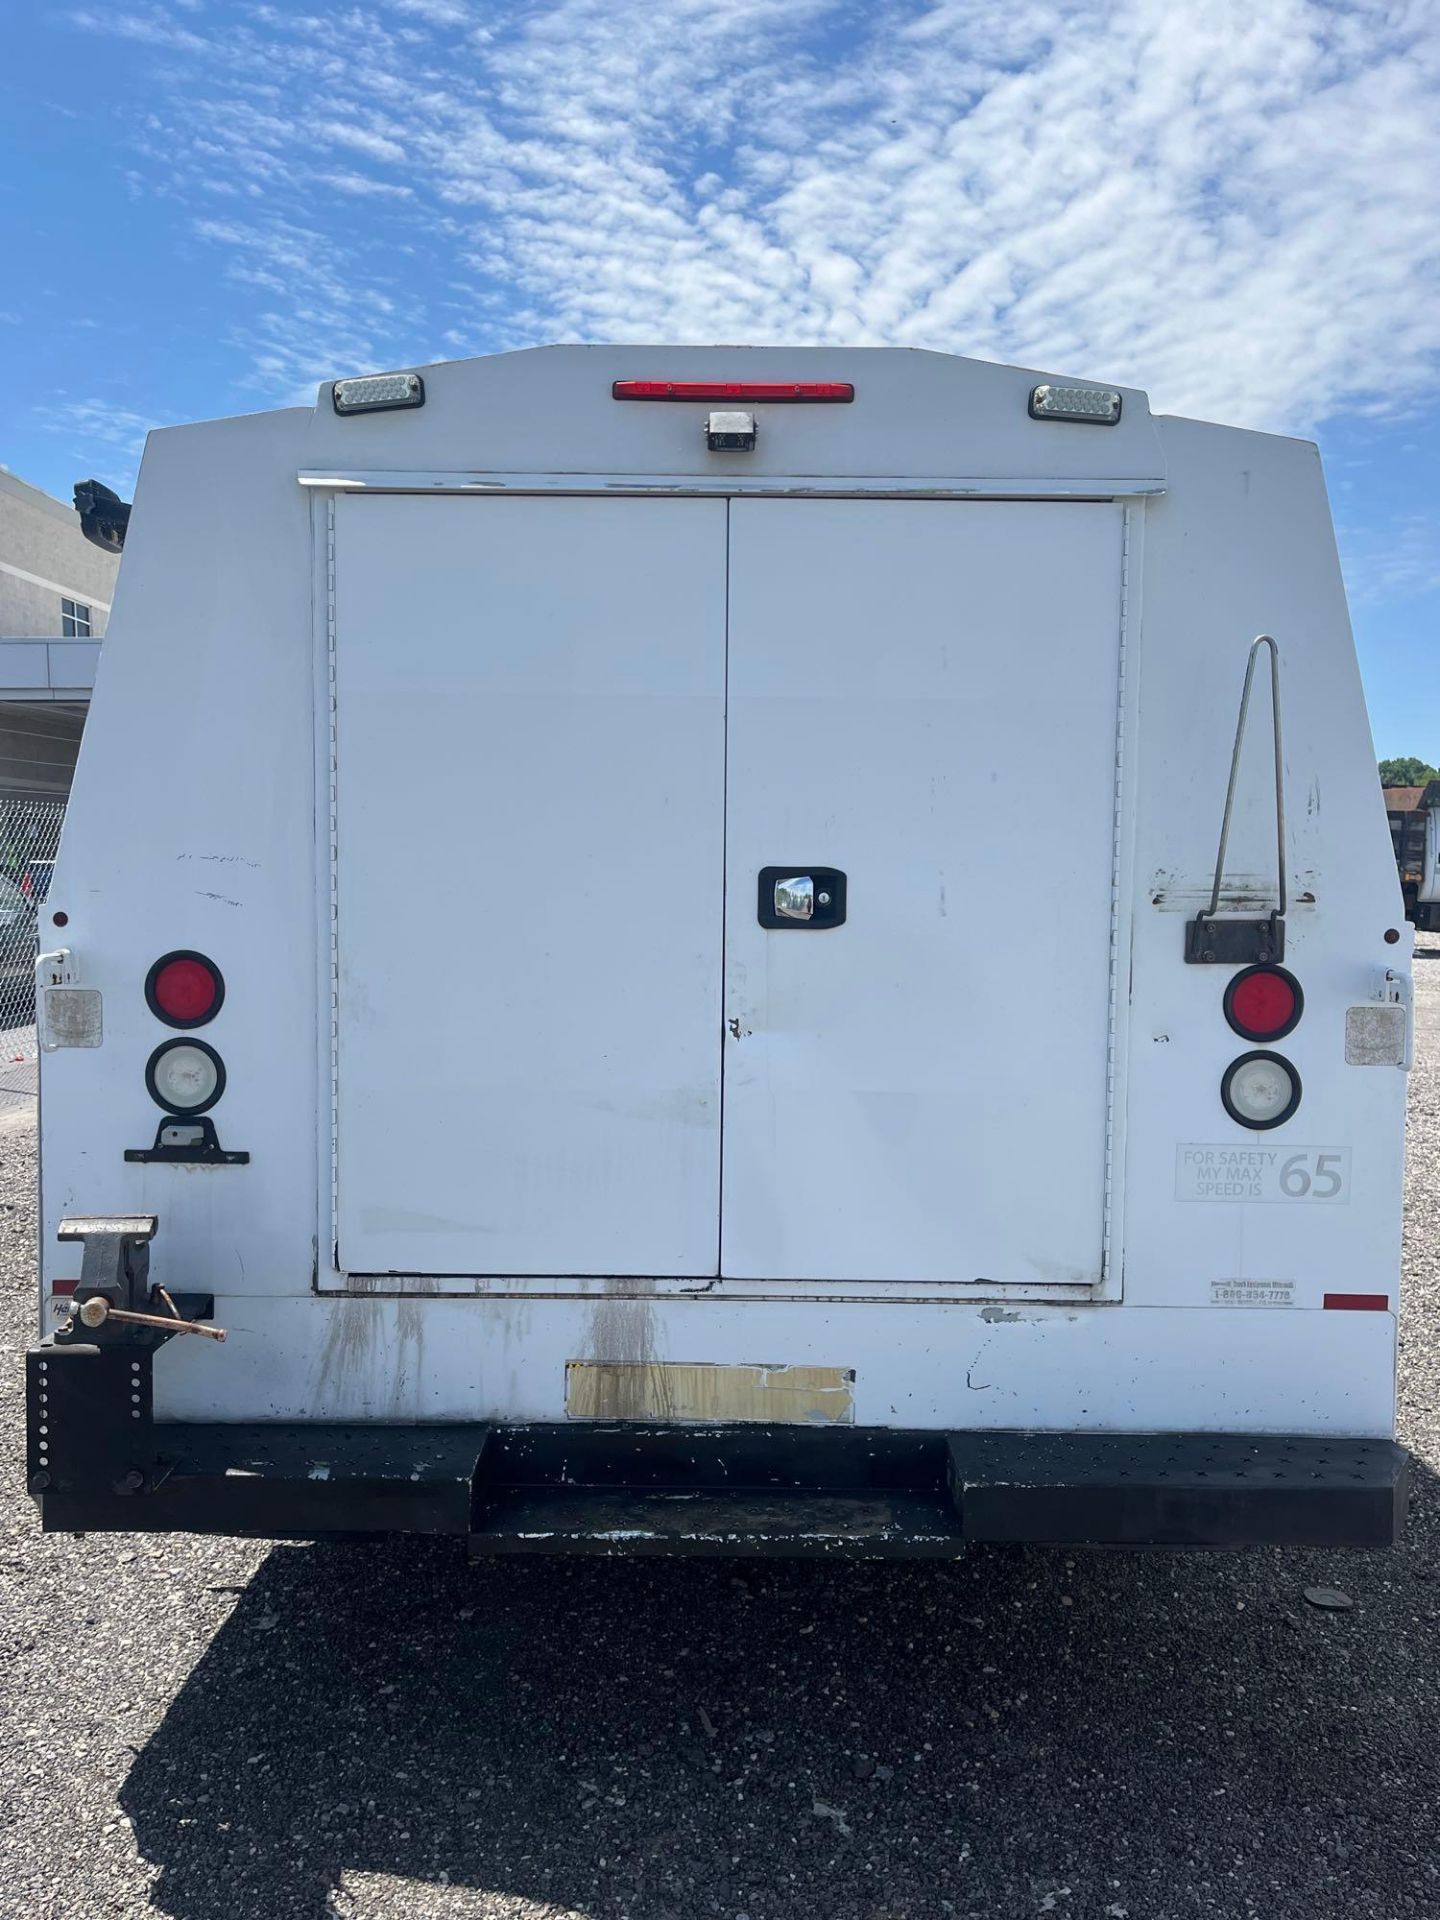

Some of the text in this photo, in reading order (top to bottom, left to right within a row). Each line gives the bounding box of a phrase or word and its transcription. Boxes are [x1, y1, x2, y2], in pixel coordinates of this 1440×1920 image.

[1184, 1151, 1277, 1166] FOR SAFETY
[1196, 1166, 1262, 1181] MY MAX
[1279, 1154, 1342, 1198] 65
[1196, 1182, 1262, 1197] SPEED IS
